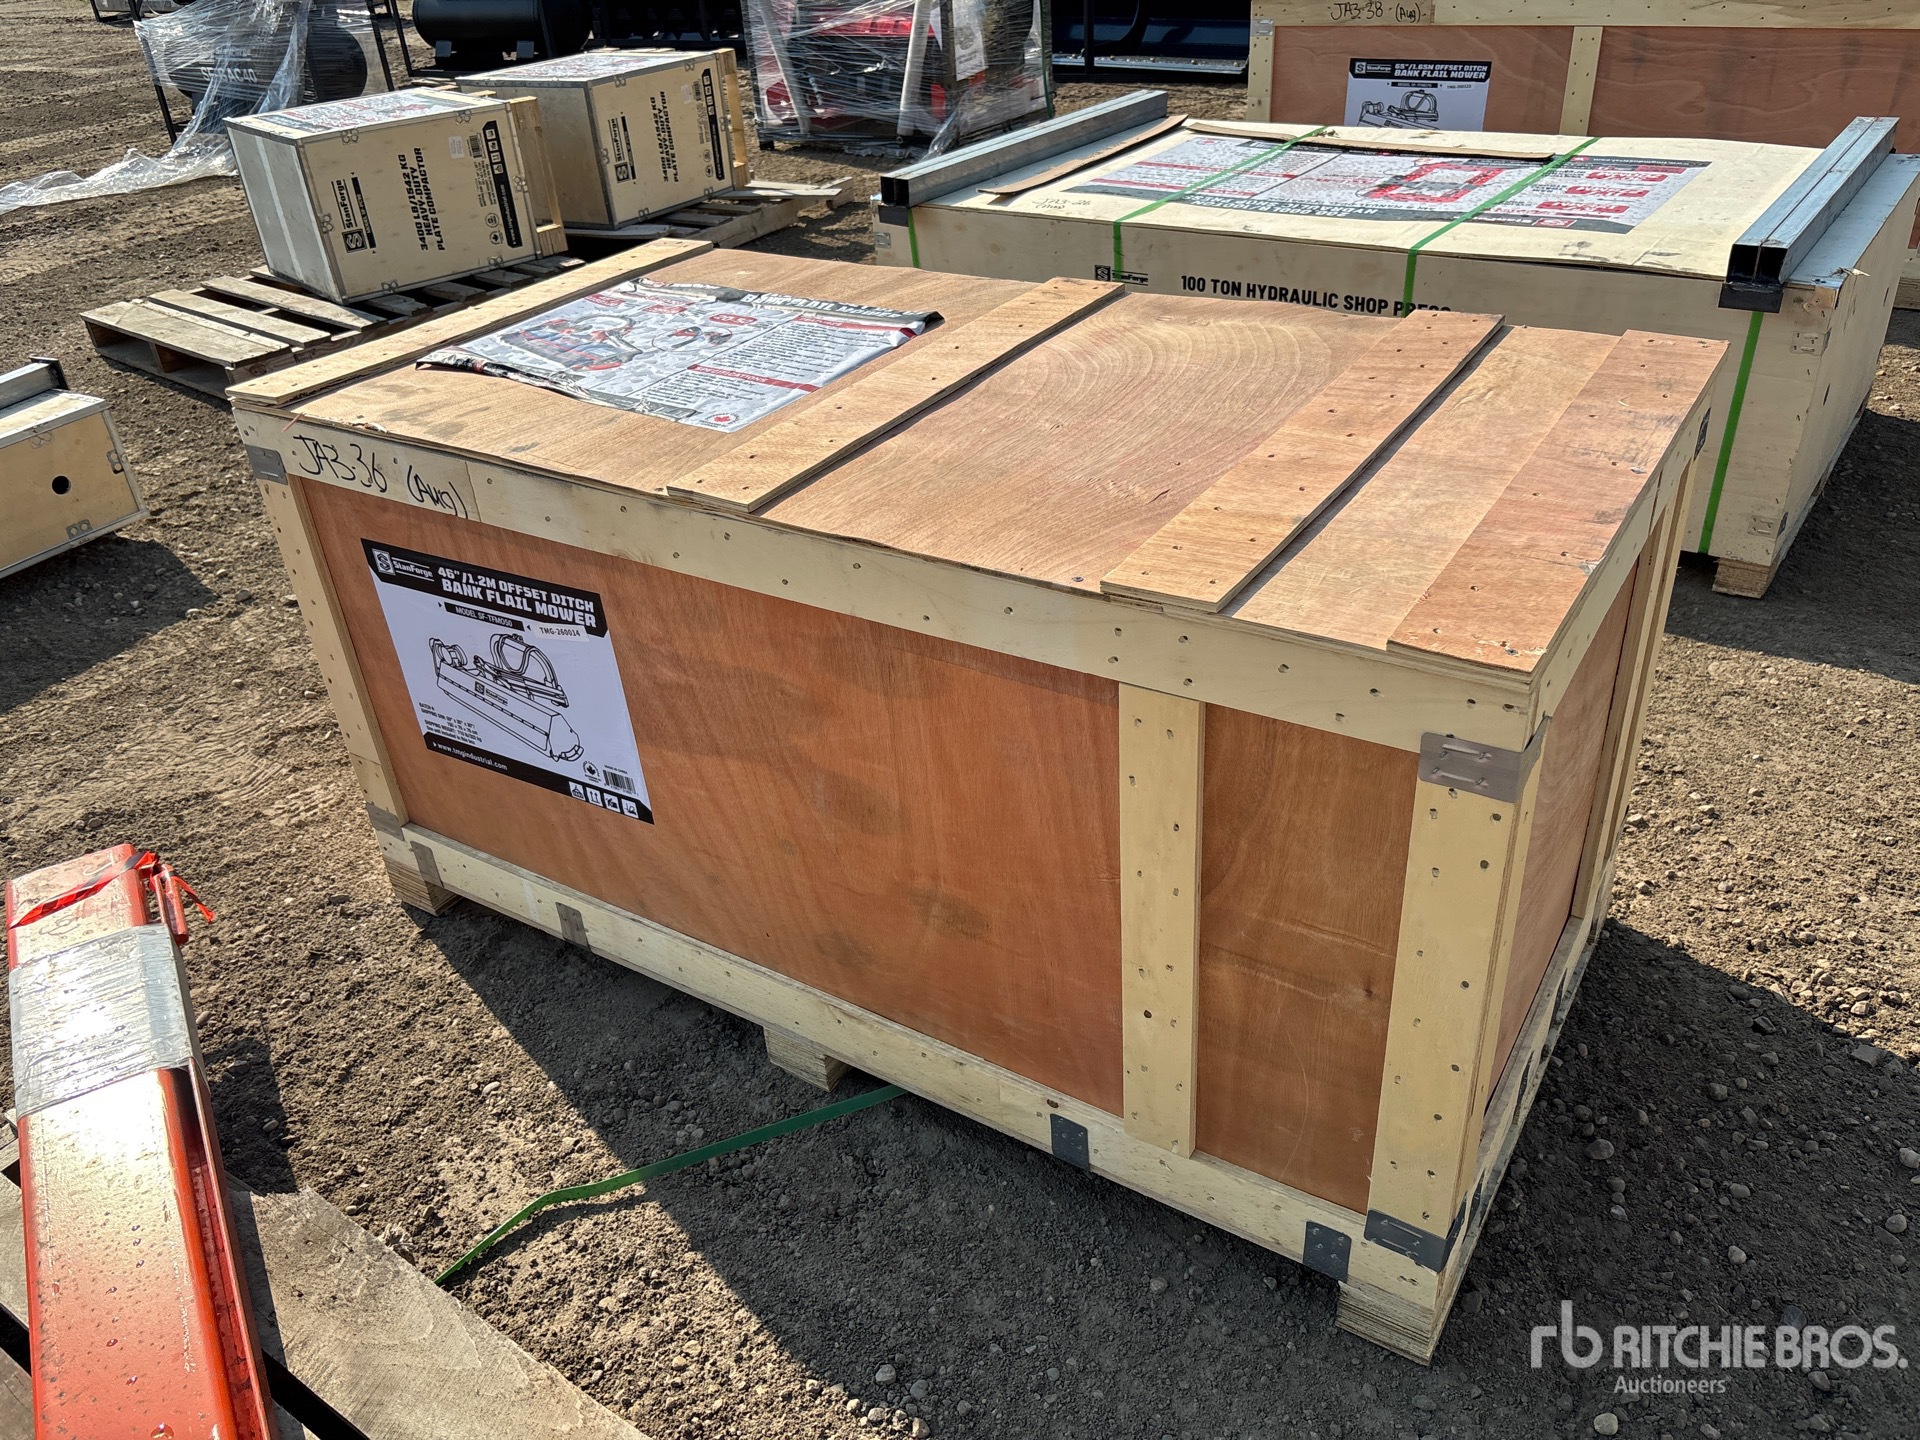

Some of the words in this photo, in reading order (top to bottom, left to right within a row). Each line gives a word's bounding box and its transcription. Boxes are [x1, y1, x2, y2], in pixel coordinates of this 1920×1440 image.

[1394, 69, 1419, 77] BANK
[1421, 70, 1448, 78] FLAIL
[1450, 71, 1486, 79] MOWER
[1435, 64, 1463, 72] OFFSET
[398, 154, 408, 170] KG
[670, 152, 679, 182] PLATE
[402, 172, 420, 220] LB/1542
[413, 147, 436, 215] COMPACTOR
[336, 180, 353, 229] StanForge
[410, 166, 433, 236] HEAVY-DUTY
[1281, 203, 1379, 214] HYDRAULIC
[415, 221, 428, 251] 3400
[431, 217, 445, 251] PLATE
[1181, 275, 1206, 292] 100
[1210, 279, 1241, 297] TON
[1246, 283, 1339, 309] HYDRAULIC
[1343, 295, 1389, 315] SHOP
[393, 560, 433, 578] StanForge
[442, 579, 483, 600] BANK
[486, 590, 531, 611] FLAIL
[535, 601, 596, 628] MOWER
[499, 580, 547, 601] OFFSET
[551, 593, 594, 613] DITCH
[455, 606, 477, 619] MODEL
[540, 626, 581, 637] TMG-260014
[437, 743, 508, 770] www.tmgindustrial.com
